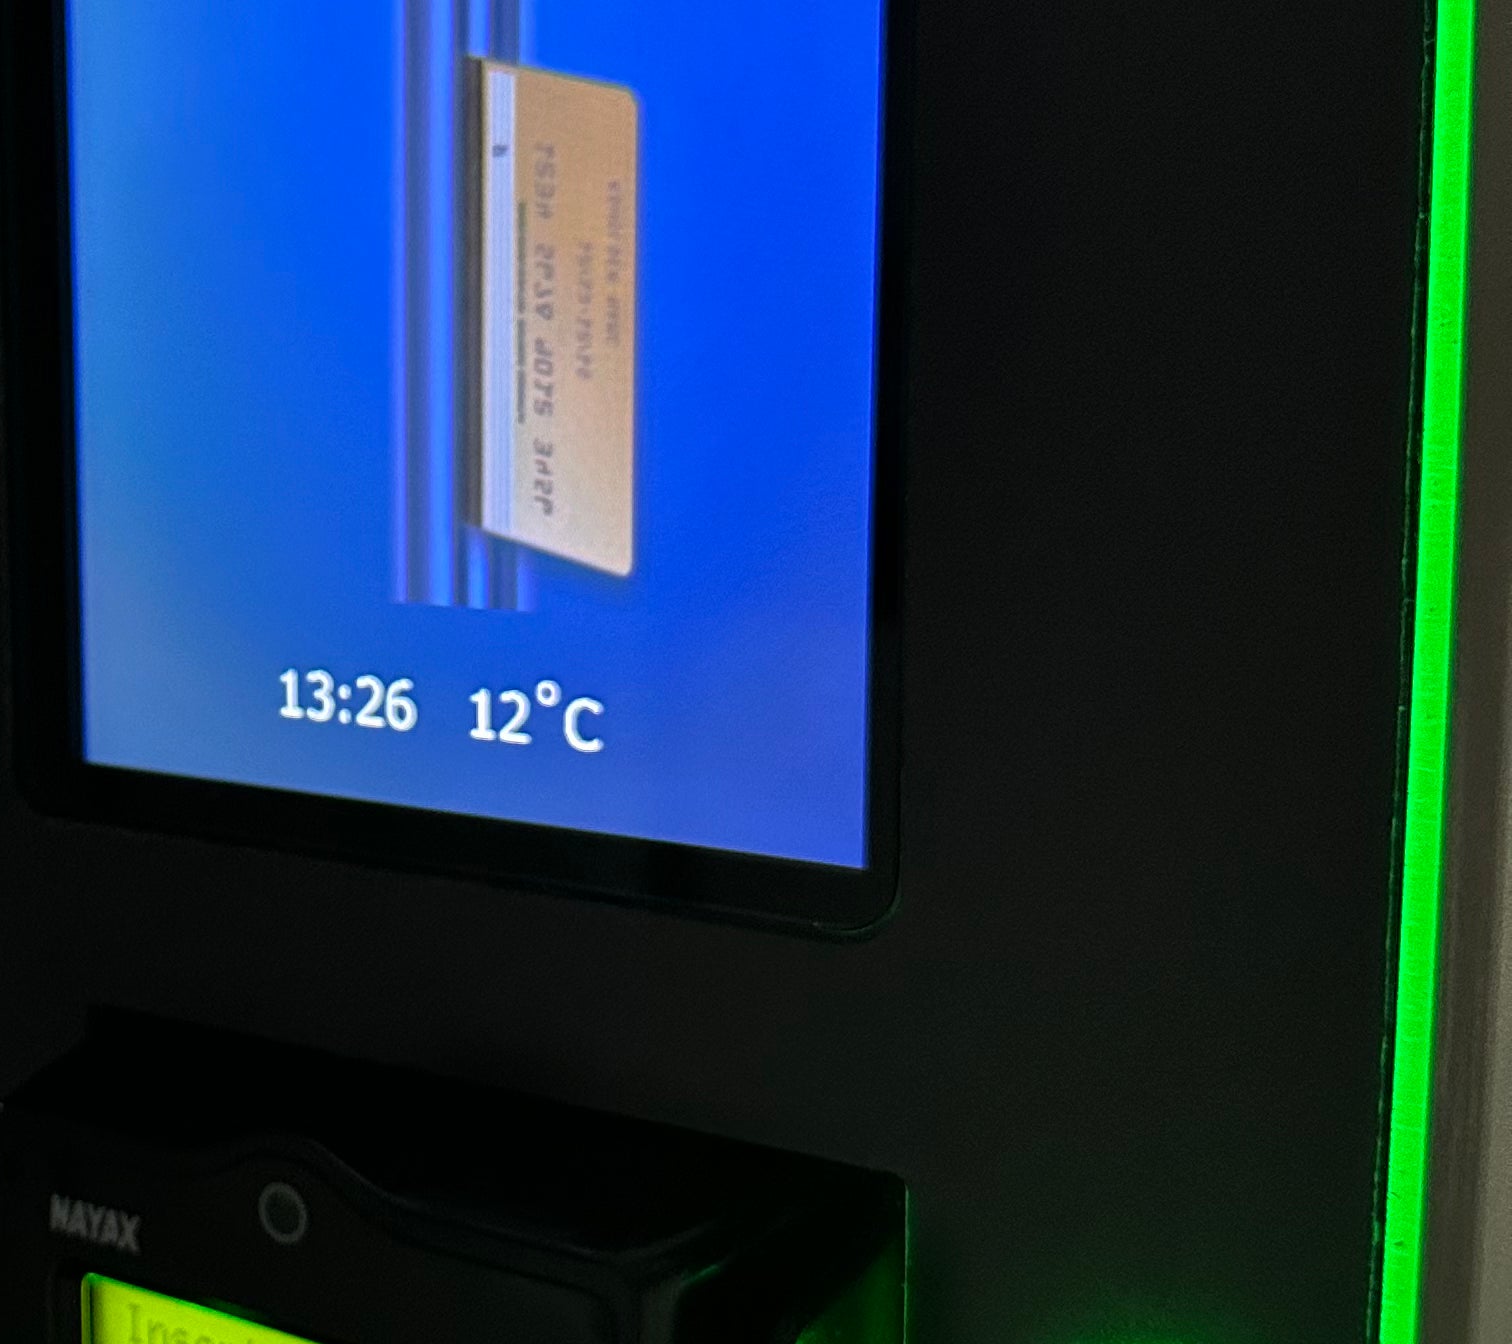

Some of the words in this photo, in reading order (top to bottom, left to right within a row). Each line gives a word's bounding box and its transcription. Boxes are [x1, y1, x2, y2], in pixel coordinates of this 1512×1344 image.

[278, 667, 419, 732] 13:26
[468, 679, 605, 753] 12°C
[50, 1194, 141, 1254] NAYAX
